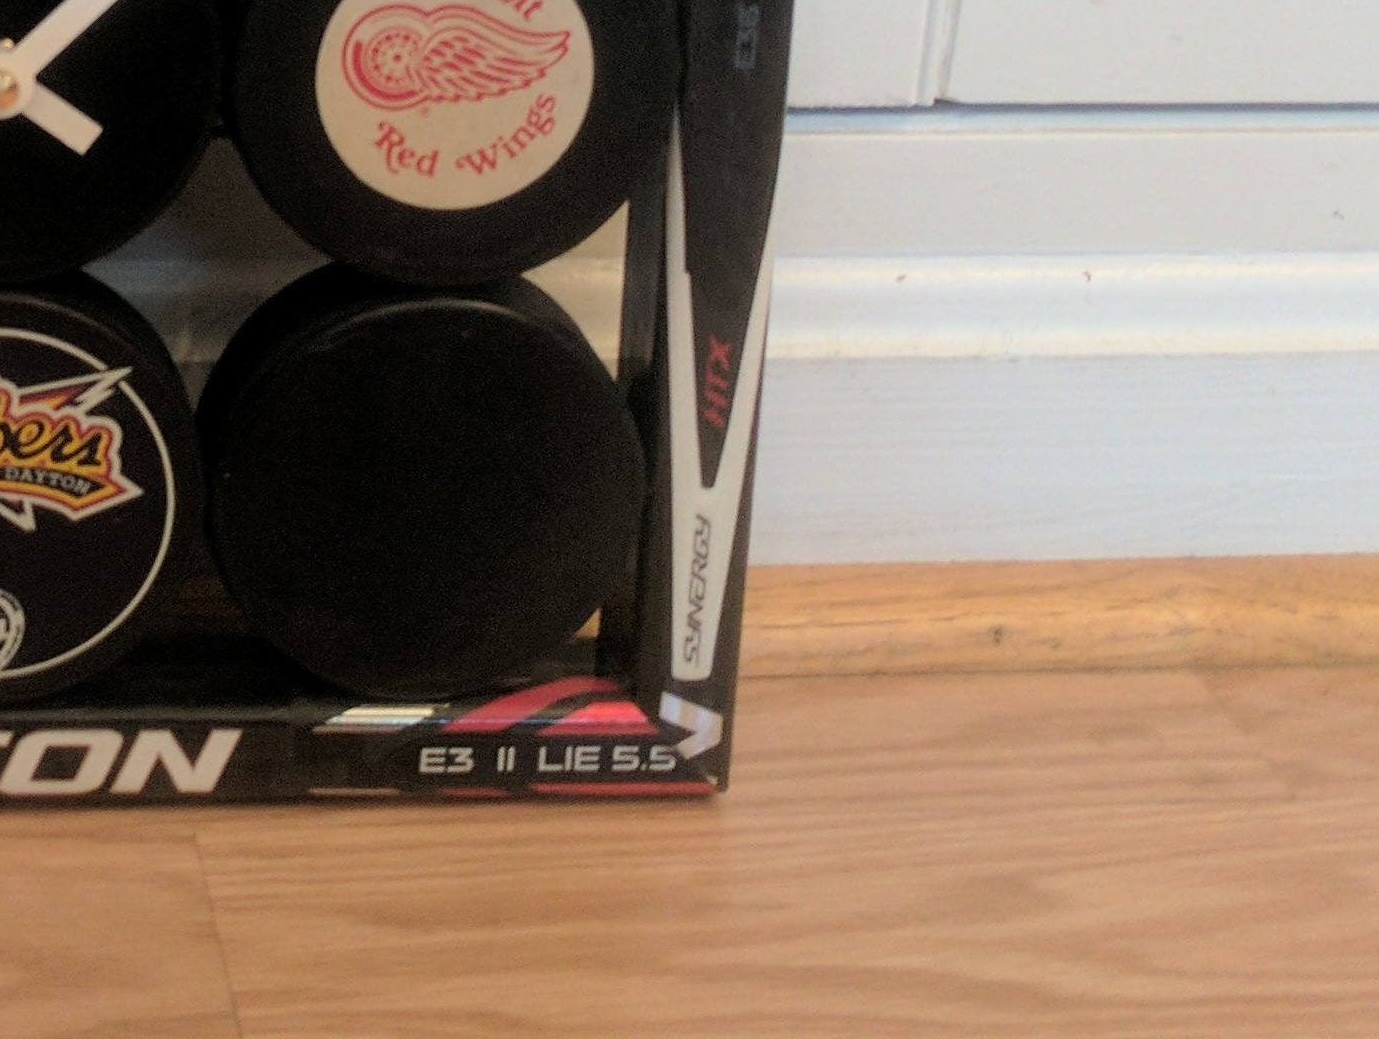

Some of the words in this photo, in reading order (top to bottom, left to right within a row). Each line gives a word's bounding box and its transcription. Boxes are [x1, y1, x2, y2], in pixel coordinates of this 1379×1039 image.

[375, 120, 440, 178] Red
[455, 93, 556, 176] Wings
[4, 465, 91, 496] DAYTON
[684, 514, 713, 664] SYNERGY
[419, 747, 474, 774] E3
[537, 745, 602, 772] LIE
[611, 745, 677, 772] 5.5
